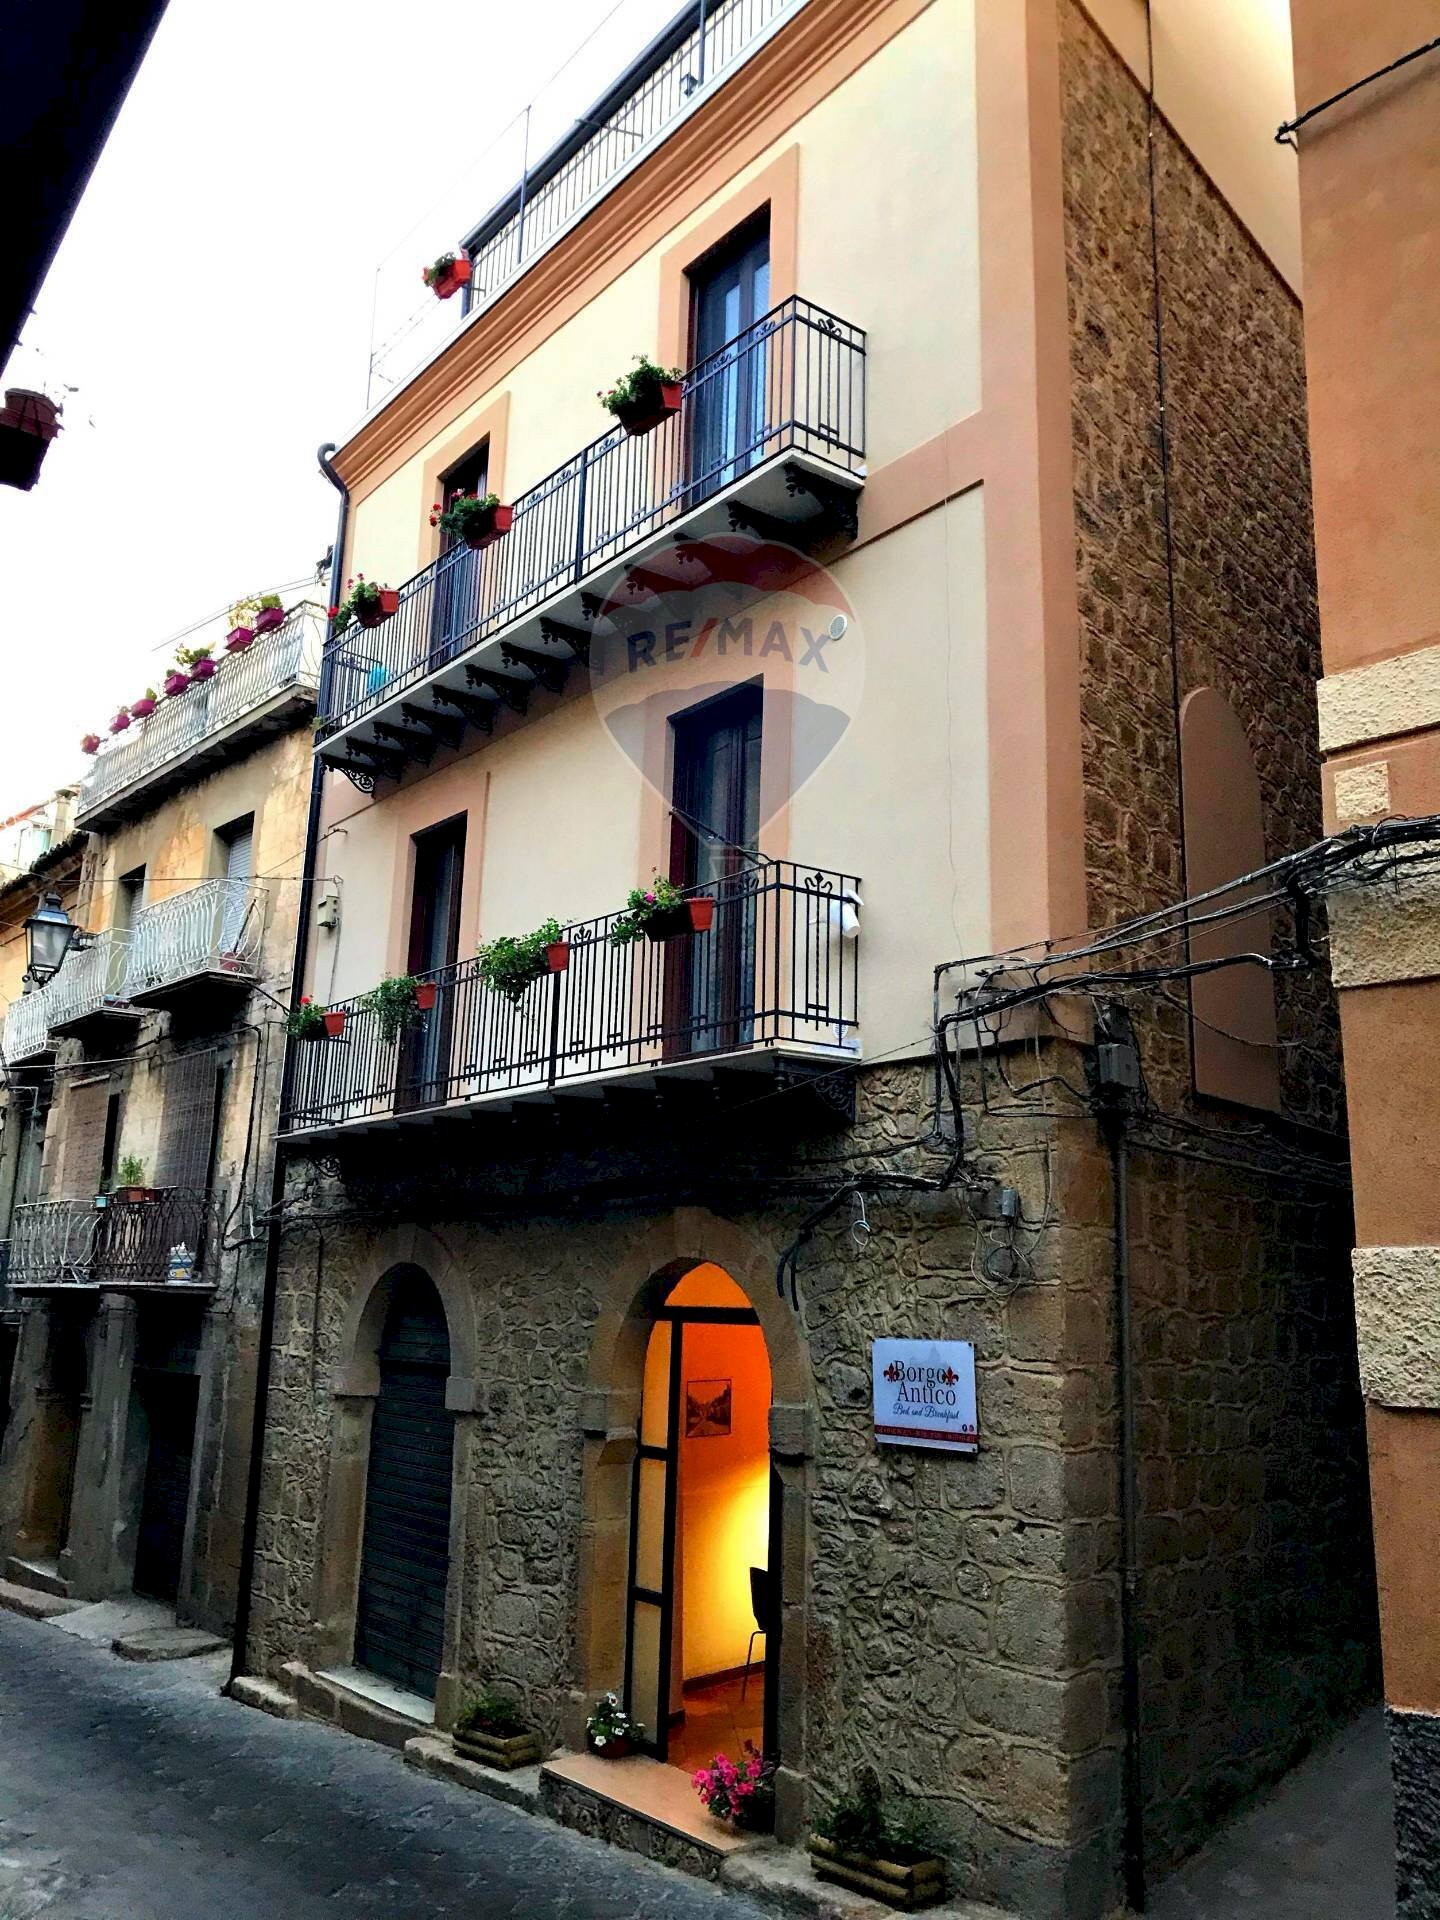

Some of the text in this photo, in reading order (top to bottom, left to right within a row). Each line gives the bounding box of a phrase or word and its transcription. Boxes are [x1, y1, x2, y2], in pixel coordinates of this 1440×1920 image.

[894, 1360, 946, 1389] Borgo
[897, 1381, 956, 1406] Antico
[892, 1402, 960, 1423] Bed and Breakfast
